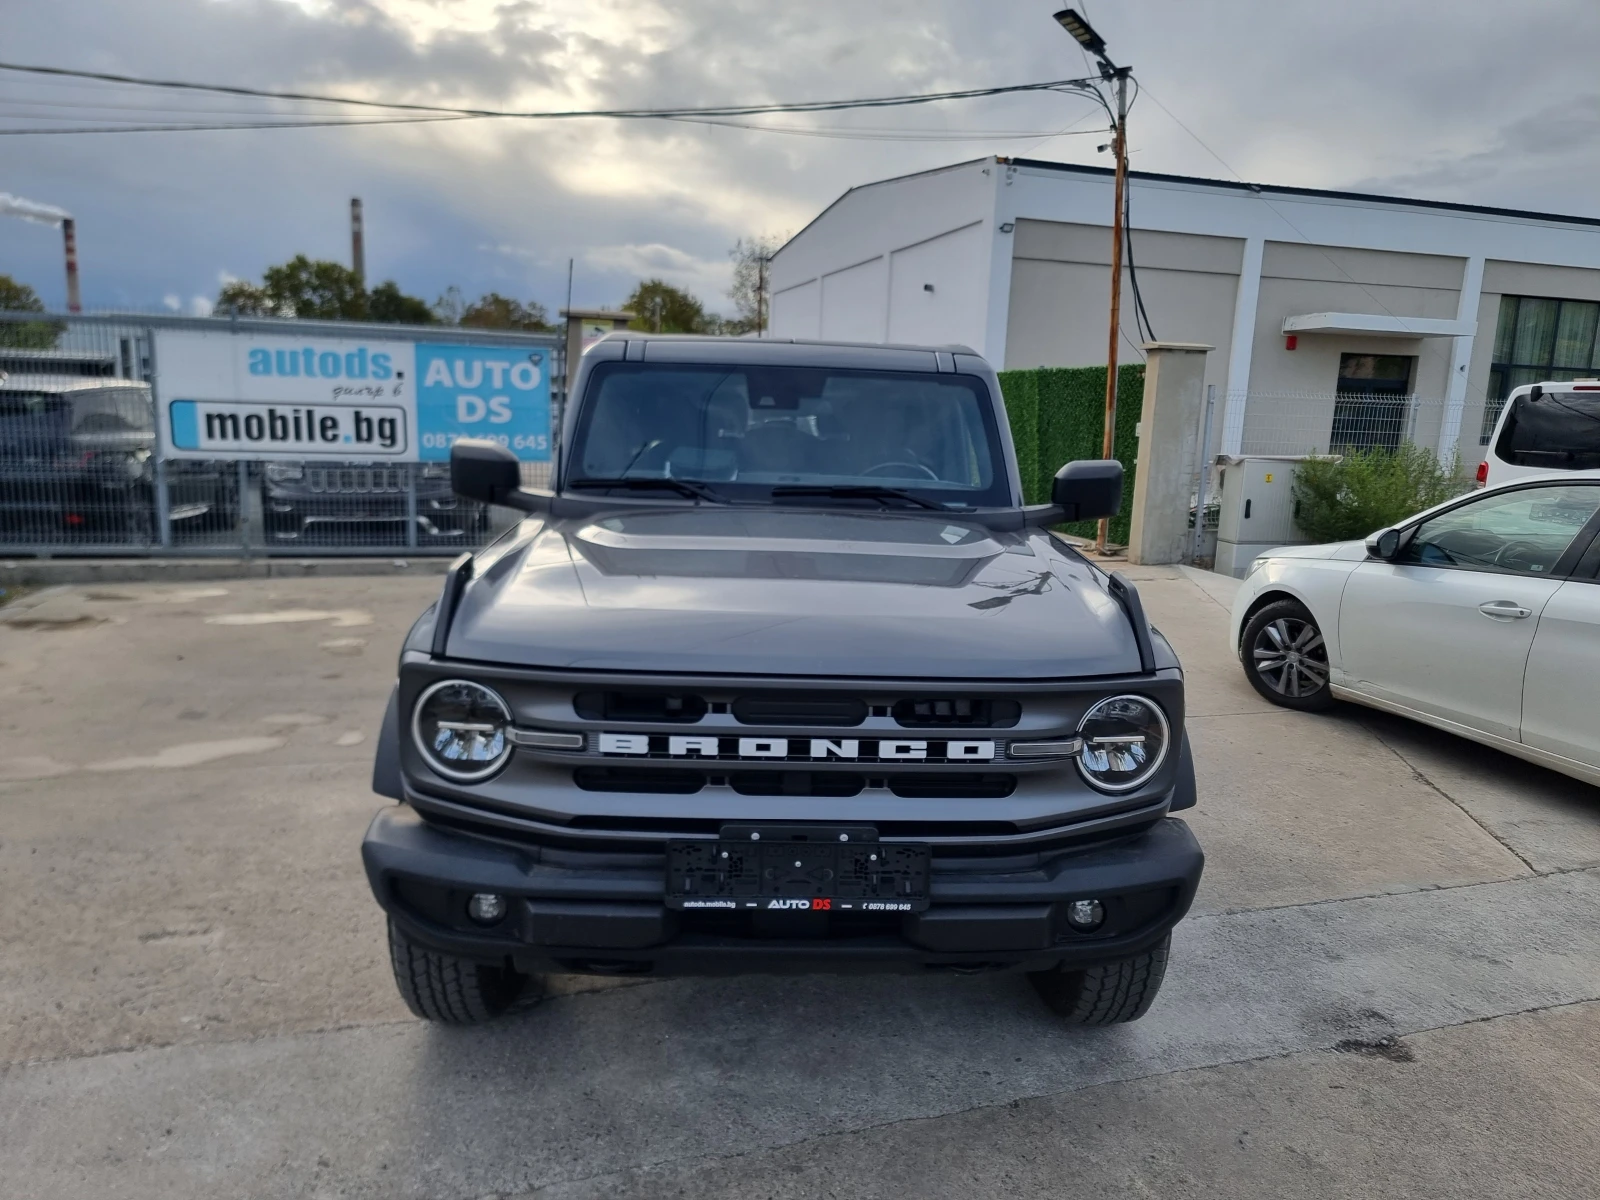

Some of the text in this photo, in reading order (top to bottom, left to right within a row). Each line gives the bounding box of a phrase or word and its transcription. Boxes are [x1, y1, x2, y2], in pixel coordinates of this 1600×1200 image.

[424, 358, 541, 390] AUTO
[457, 395, 513, 424] DS
[206, 408, 397, 448] mobile.bg
[513, 433, 547, 449] 645
[599, 733, 995, 759] BRONCO
[767, 899, 810, 910] AUTO
[812, 898, 831, 910] DS
